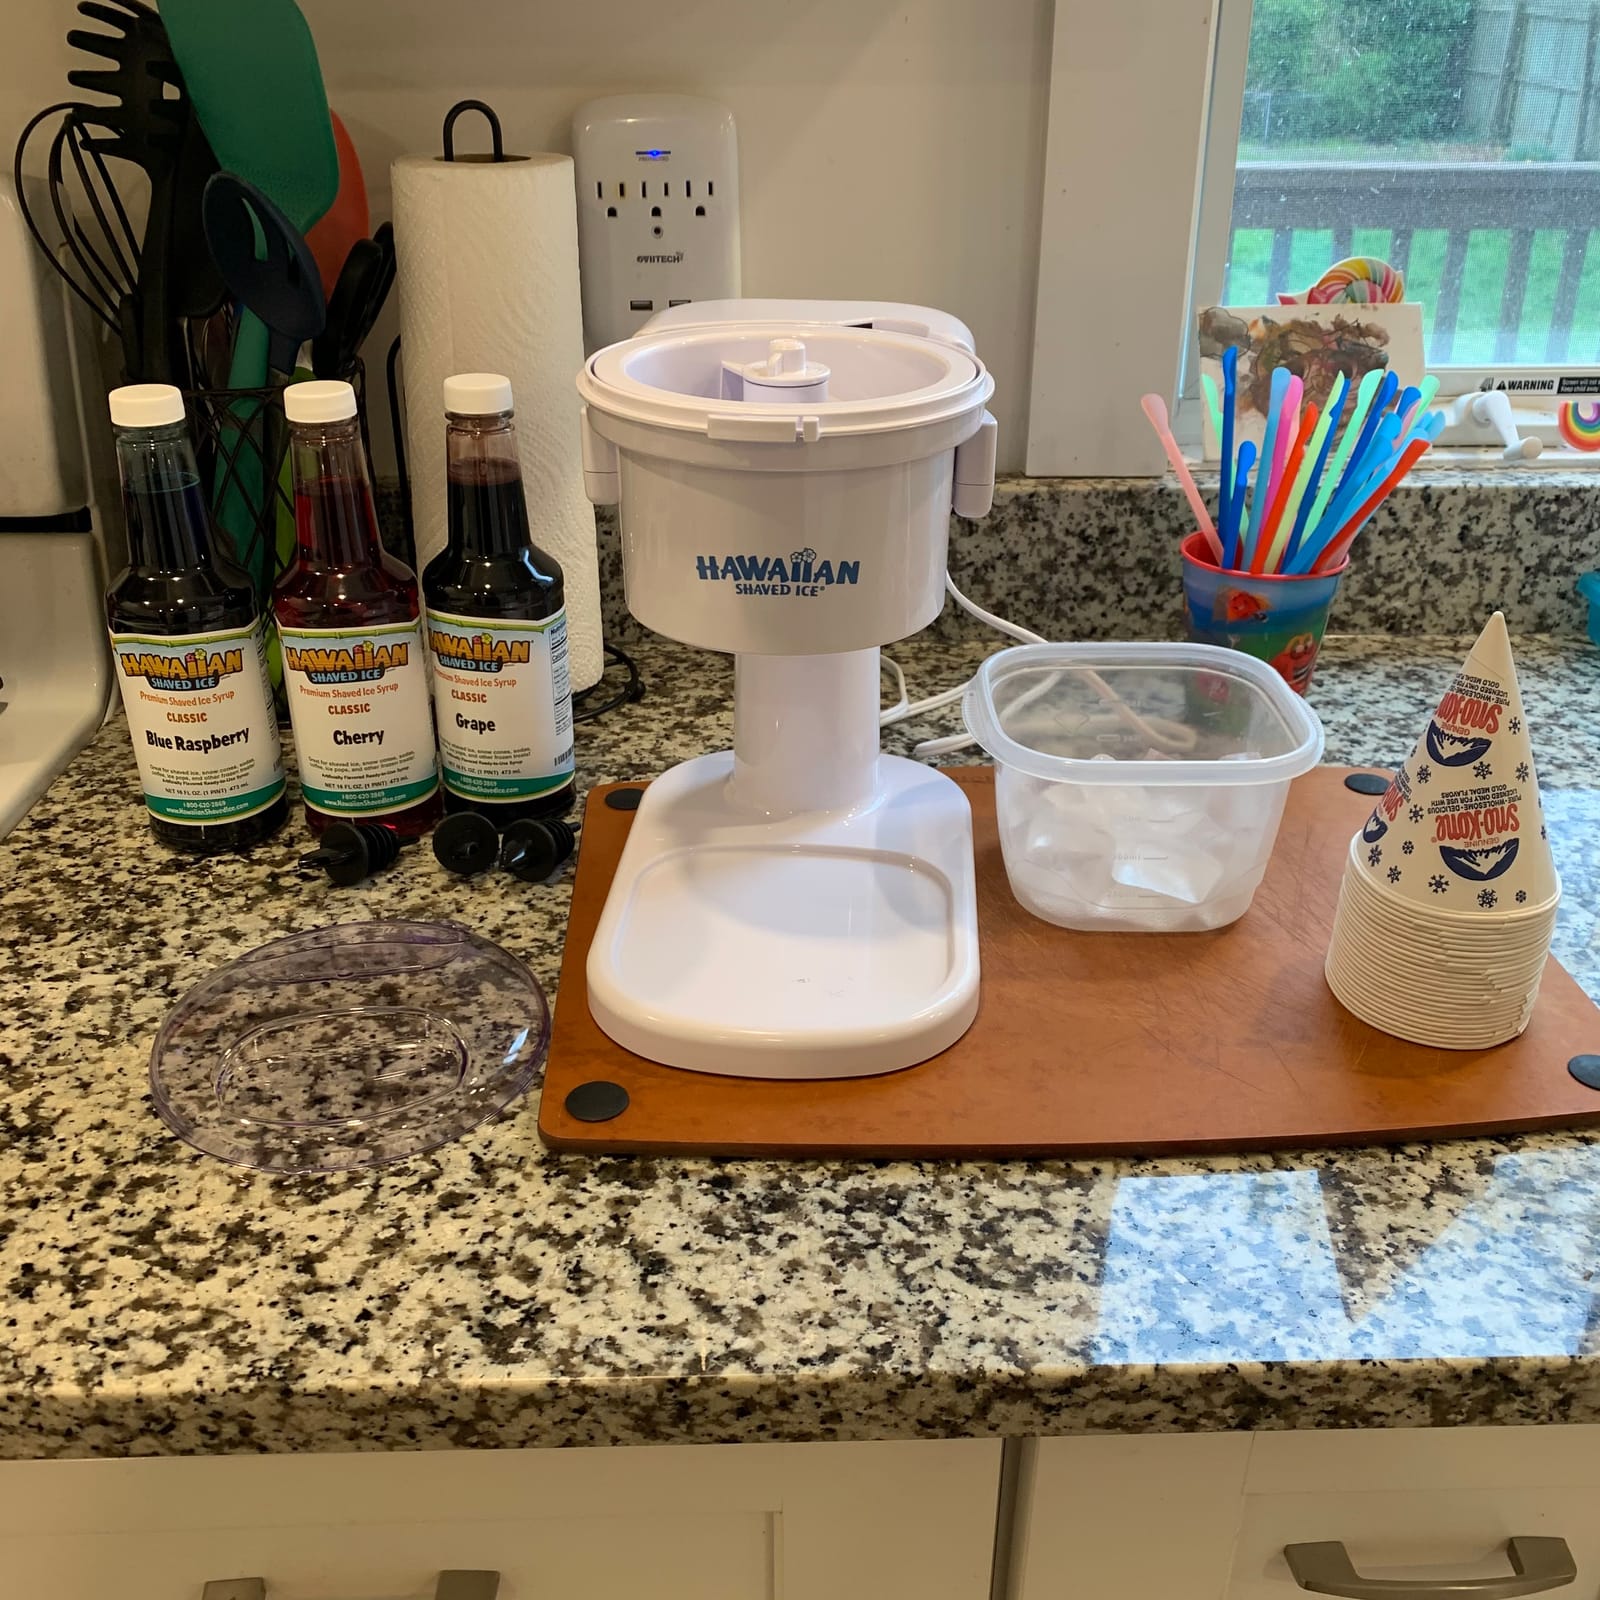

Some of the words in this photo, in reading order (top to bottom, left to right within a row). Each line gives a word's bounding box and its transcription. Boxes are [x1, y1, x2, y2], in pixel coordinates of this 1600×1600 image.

[1508, 380, 1554, 390] WARNING
[696, 548, 860, 584] HAWAIIAN
[736, 584, 791, 596] SHAVED
[796, 586, 819, 597] ICE
[285, 641, 409, 672] HAWAIIAN
[120, 648, 243, 679] HAWAIIAN
[441, 655, 476, 669] SHAVED
[480, 661, 498, 671] ICE
[312, 671, 358, 683] SHAVED
[361, 669, 381, 680] ICE
[151, 678, 192, 689] SHAVED
[196, 677, 216, 689] ICE
[481, 679, 493, 687] Ice
[494, 679, 517, 688] Syrup
[1482, 679, 1500, 689] GOLD
[300, 686, 331, 698] Premium
[332, 688, 362, 698] Shaved
[363, 687, 376, 696] Ice
[377, 682, 399, 696] Syrup
[452, 689, 487, 703] CLASSIC
[1480, 685, 1508, 698] LICENSED
[140, 691, 168, 704] Premium
[169, 697, 197, 707] Shaved
[199, 696, 211, 705] Ice
[213, 691, 235, 703] Syrup
[1495, 697, 1510, 707] PURE
[329, 703, 371, 715] CLASSIC
[167, 712, 208, 723] CLASSIC
[456, 713, 496, 735] Grape
[146, 730, 173, 750] Blue
[175, 728, 250, 754] Raspberry
[333, 730, 385, 746] Cherry
[1441, 790, 1468, 799] FLAVORS
[1469, 787, 1490, 795] MEDAL
[1491, 784, 1507, 793] GOLD
[1492, 789, 1518, 800] LICENSED
[1474, 794, 1490, 802] ONLY
[1508, 794, 1522, 803] PURE
[1428, 804, 1460, 815] DELICIOUS
[1464, 799, 1505, 811] WHOLESOME
[1464, 837, 1500, 849] GENUINE
